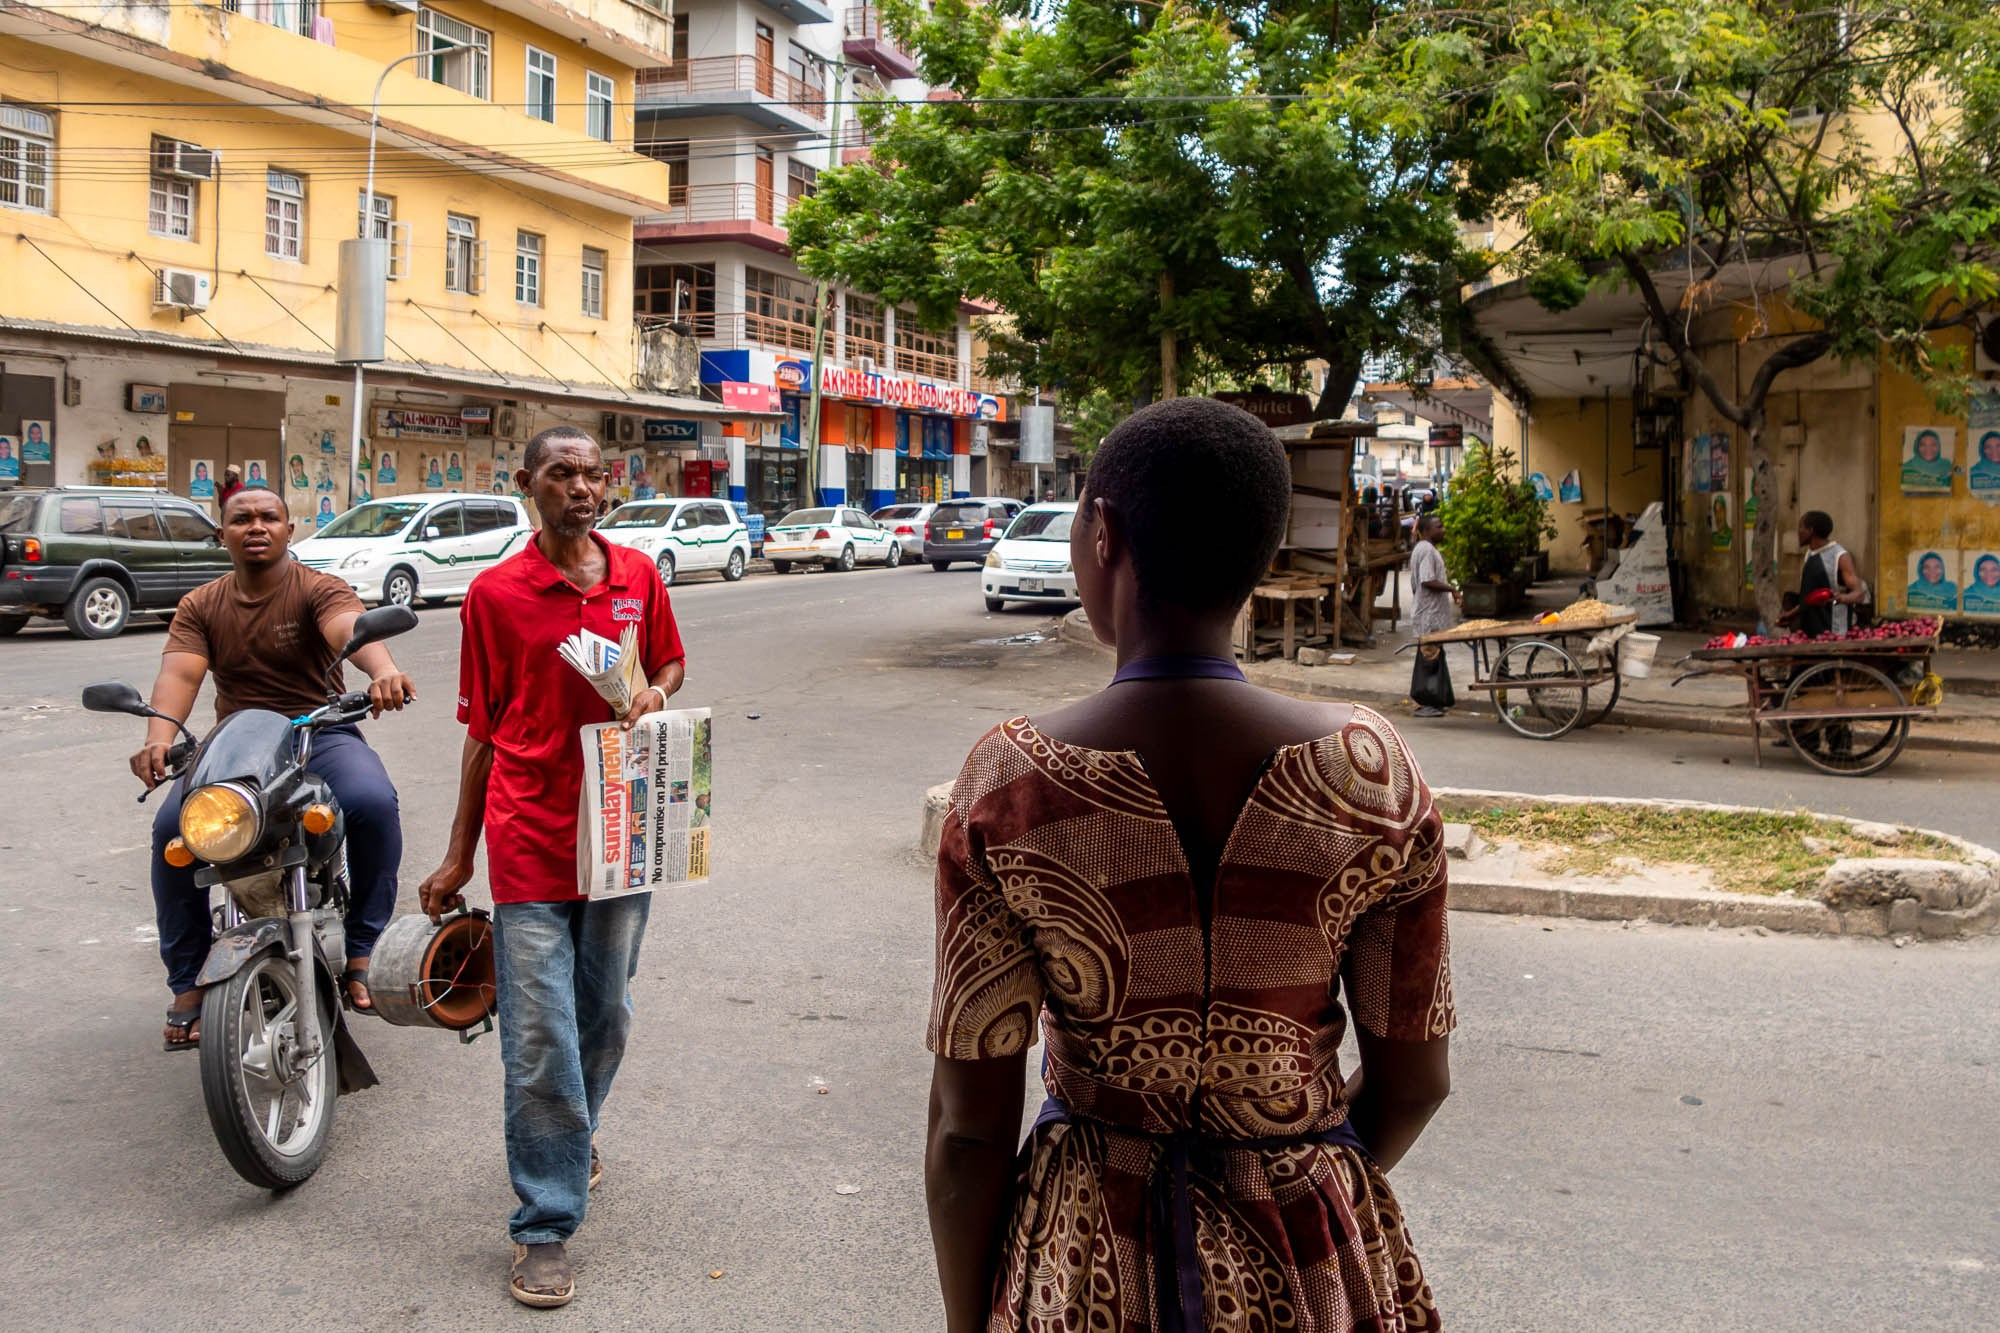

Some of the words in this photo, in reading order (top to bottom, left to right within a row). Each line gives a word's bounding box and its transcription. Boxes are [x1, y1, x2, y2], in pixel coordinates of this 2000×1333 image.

[822, 367, 878, 398] AKHRESA
[880, 378, 909, 401] FOOD
[911, 384, 960, 411] PRODUCTS
[962, 393, 978, 414] LTD
[1247, 398, 1294, 414] airtel
[648, 424, 694, 437] DStv
[655, 768, 667, 790] JPM
[656, 791, 665, 804] on
[654, 807, 669, 866] compromise
